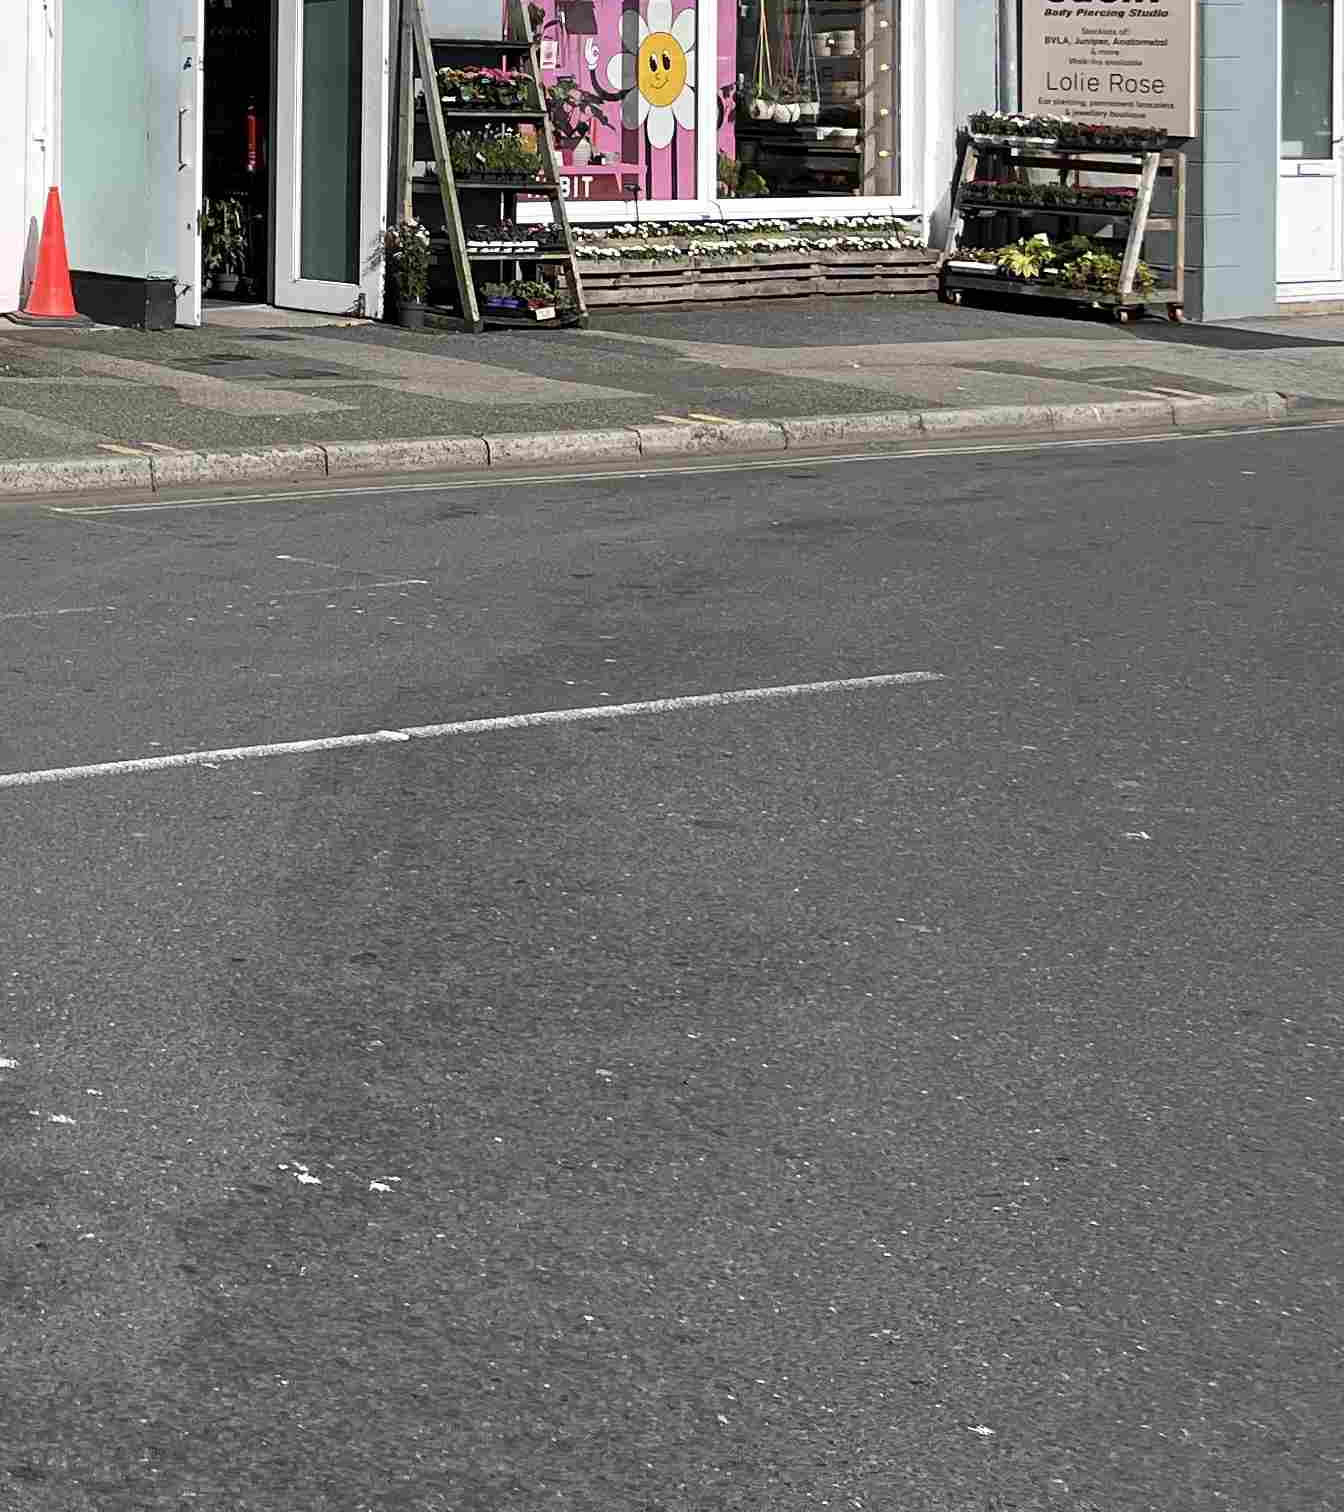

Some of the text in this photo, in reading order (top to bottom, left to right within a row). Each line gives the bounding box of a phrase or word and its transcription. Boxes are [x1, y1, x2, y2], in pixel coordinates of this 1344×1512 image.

[1044, 8, 1169, 19] Body Piercing Studio
[1046, 71, 1165, 94] Lolie Rose
